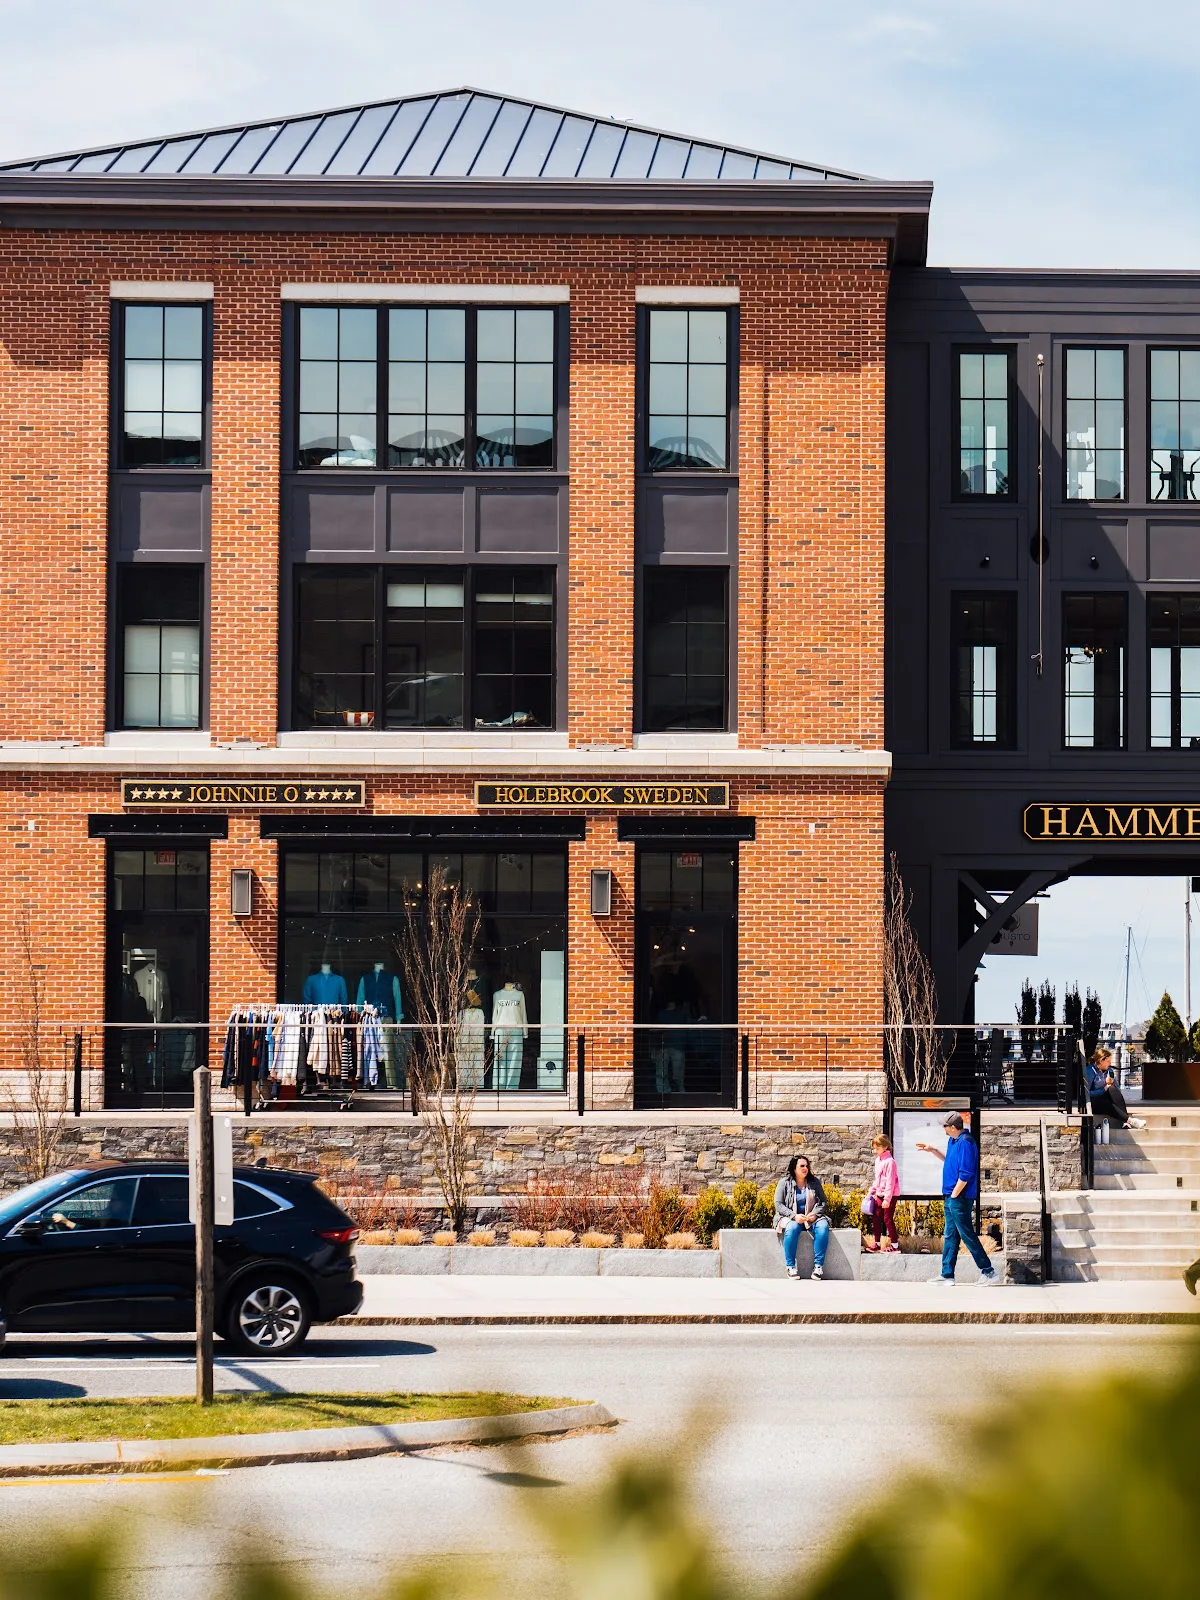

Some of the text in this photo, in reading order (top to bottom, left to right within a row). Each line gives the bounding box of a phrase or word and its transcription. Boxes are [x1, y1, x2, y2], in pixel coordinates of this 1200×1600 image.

[187, 786, 298, 802] JOHNNIE O
[494, 787, 709, 803] HOLEBROOK SWEDEN
